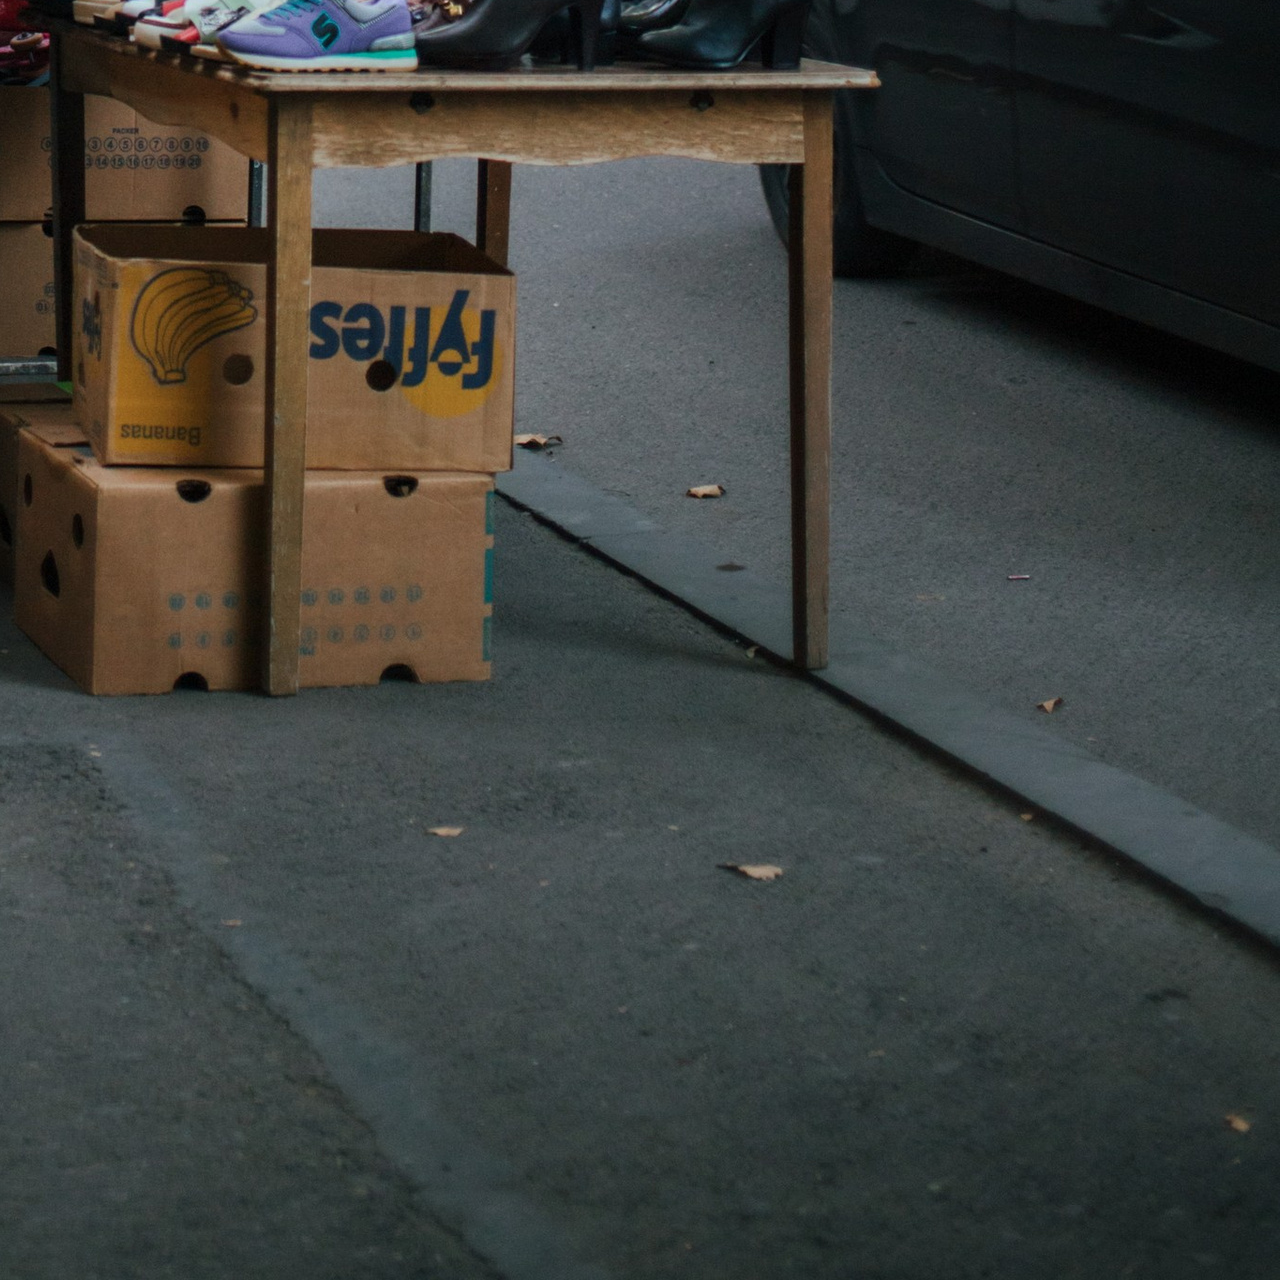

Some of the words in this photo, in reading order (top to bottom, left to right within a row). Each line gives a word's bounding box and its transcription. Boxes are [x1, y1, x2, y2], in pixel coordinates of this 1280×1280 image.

[112, 127, 139, 135] PACKER
[309, 289, 496, 390] fyffes
[120, 424, 202, 446] Bananas
